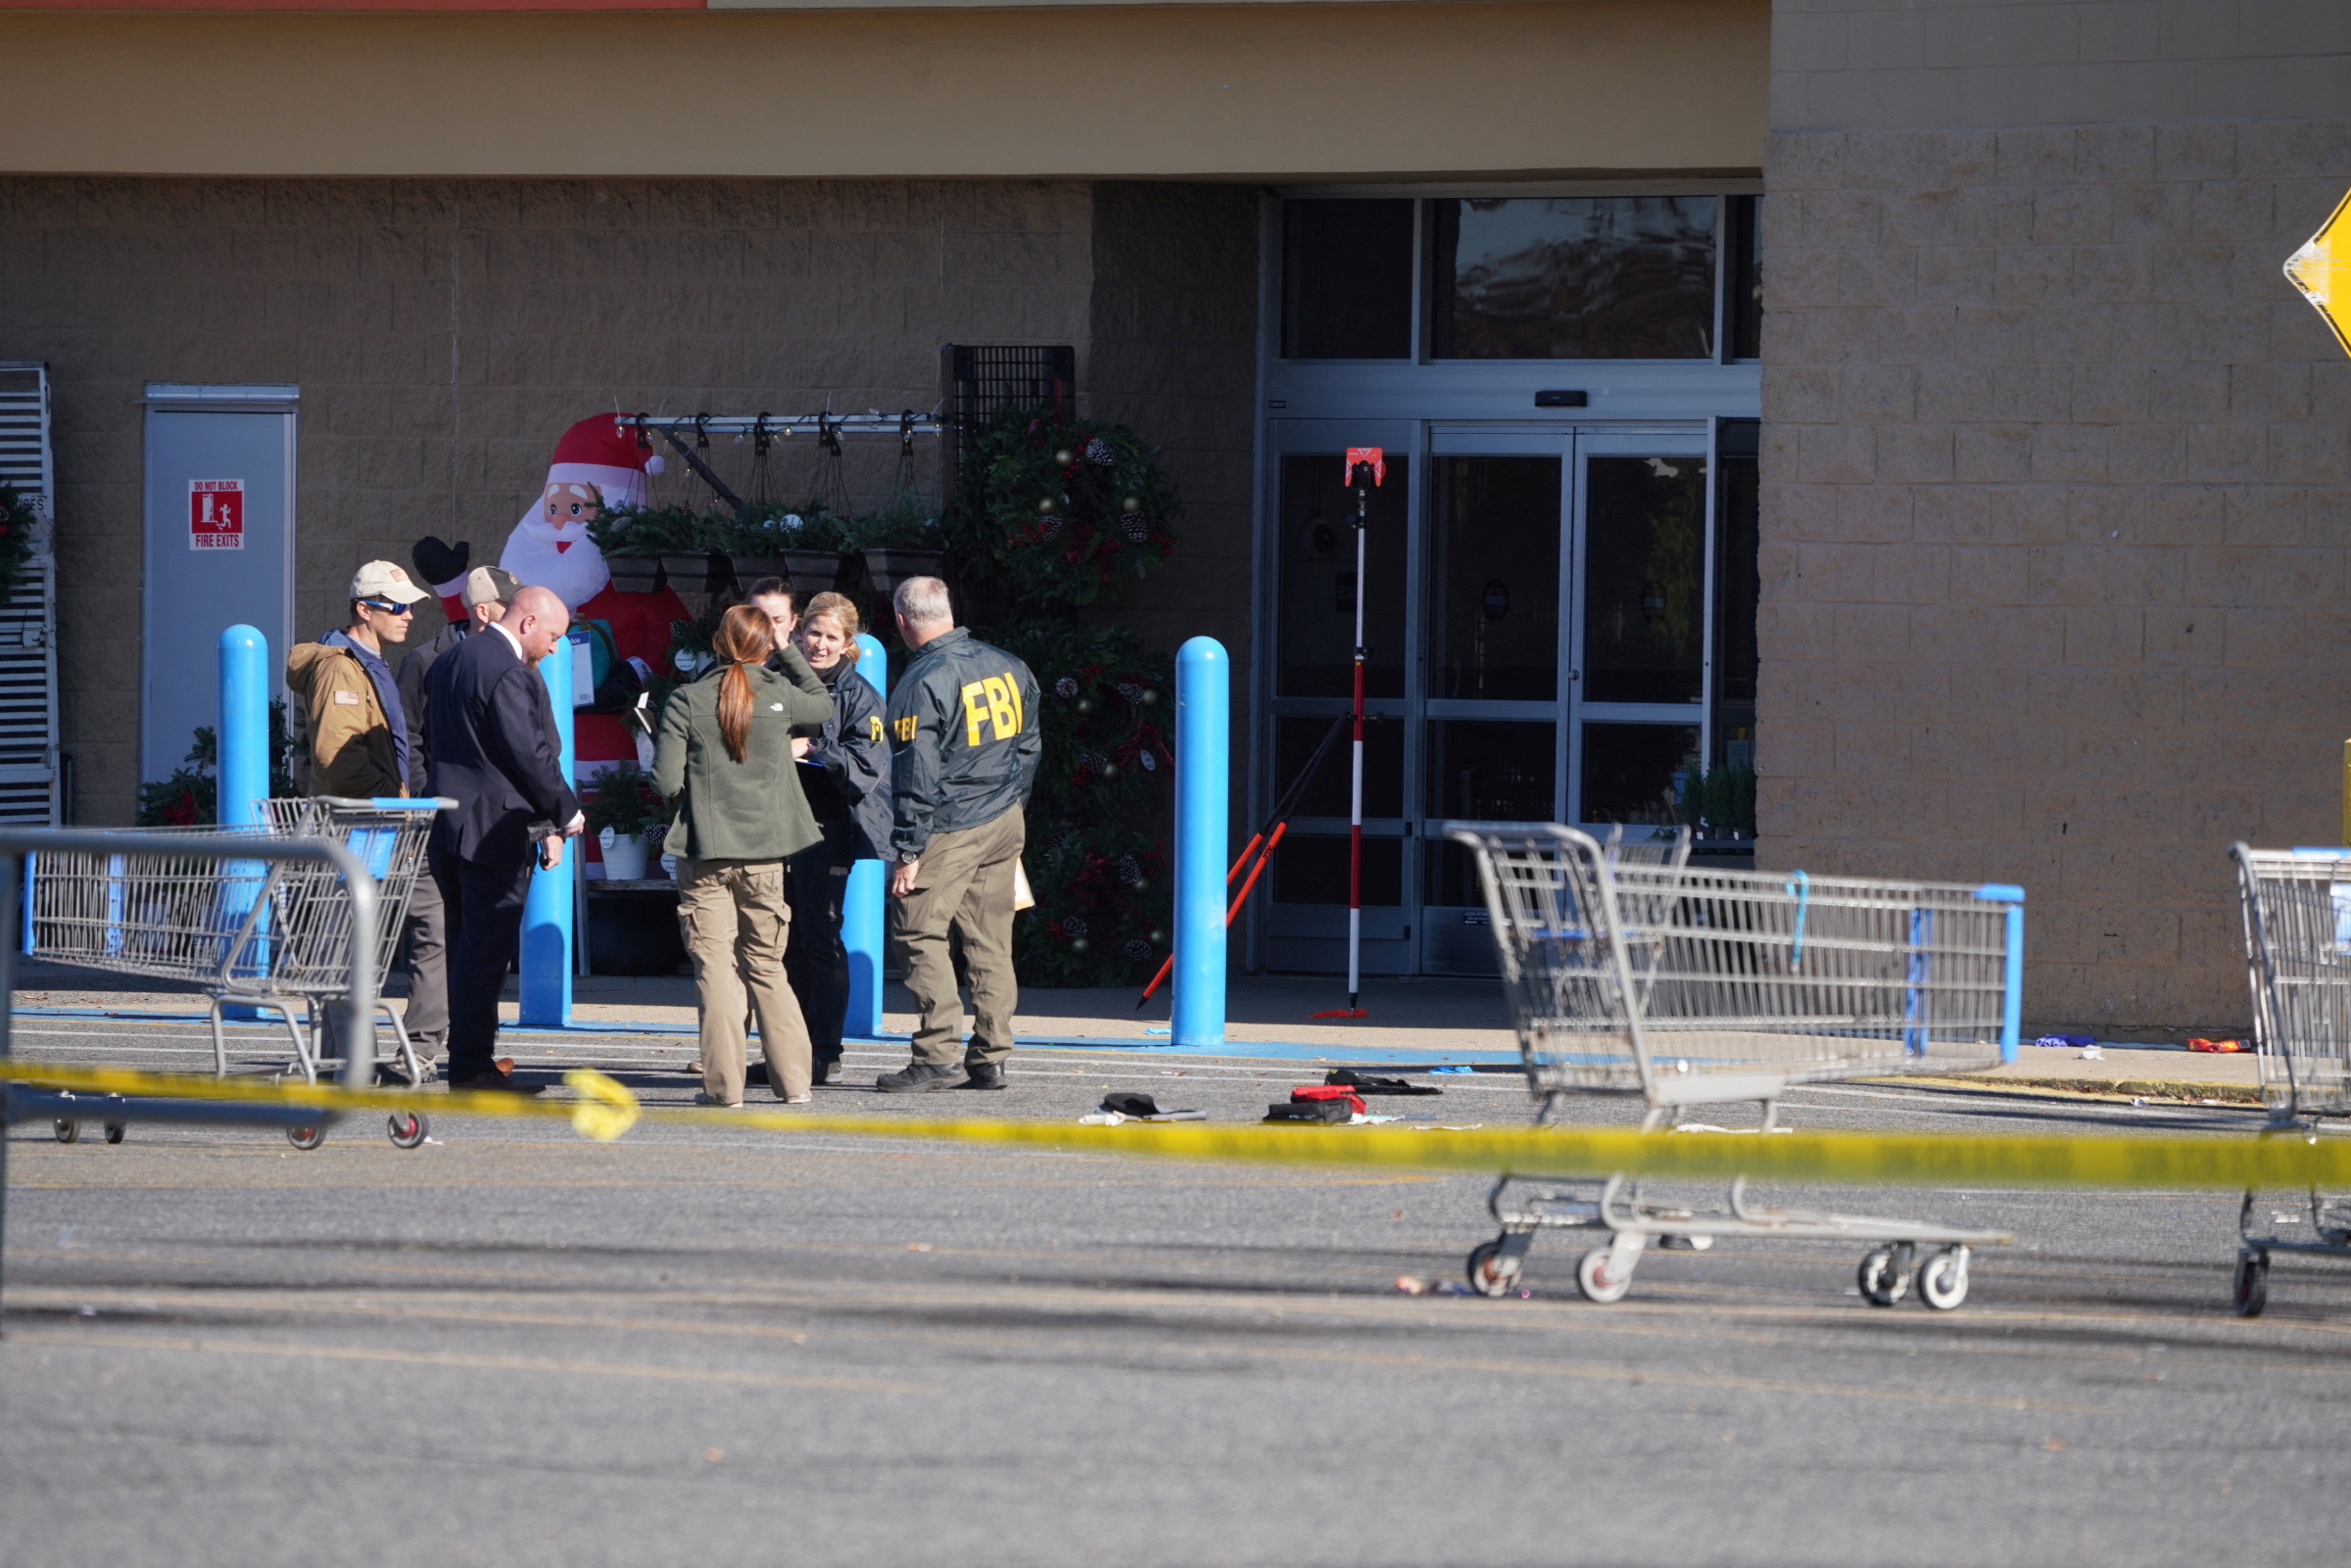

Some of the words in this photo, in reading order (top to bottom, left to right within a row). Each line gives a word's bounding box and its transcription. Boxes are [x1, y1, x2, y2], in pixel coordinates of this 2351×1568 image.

[194, 481, 204, 491] DO
[205, 481, 216, 491] NOT
[217, 481, 238, 491] BLOCK
[195, 534, 214, 547] FIRE
[216, 534, 239, 547] EXITS
[961, 672, 1023, 747] FBI
[894, 715, 919, 742] FBI
